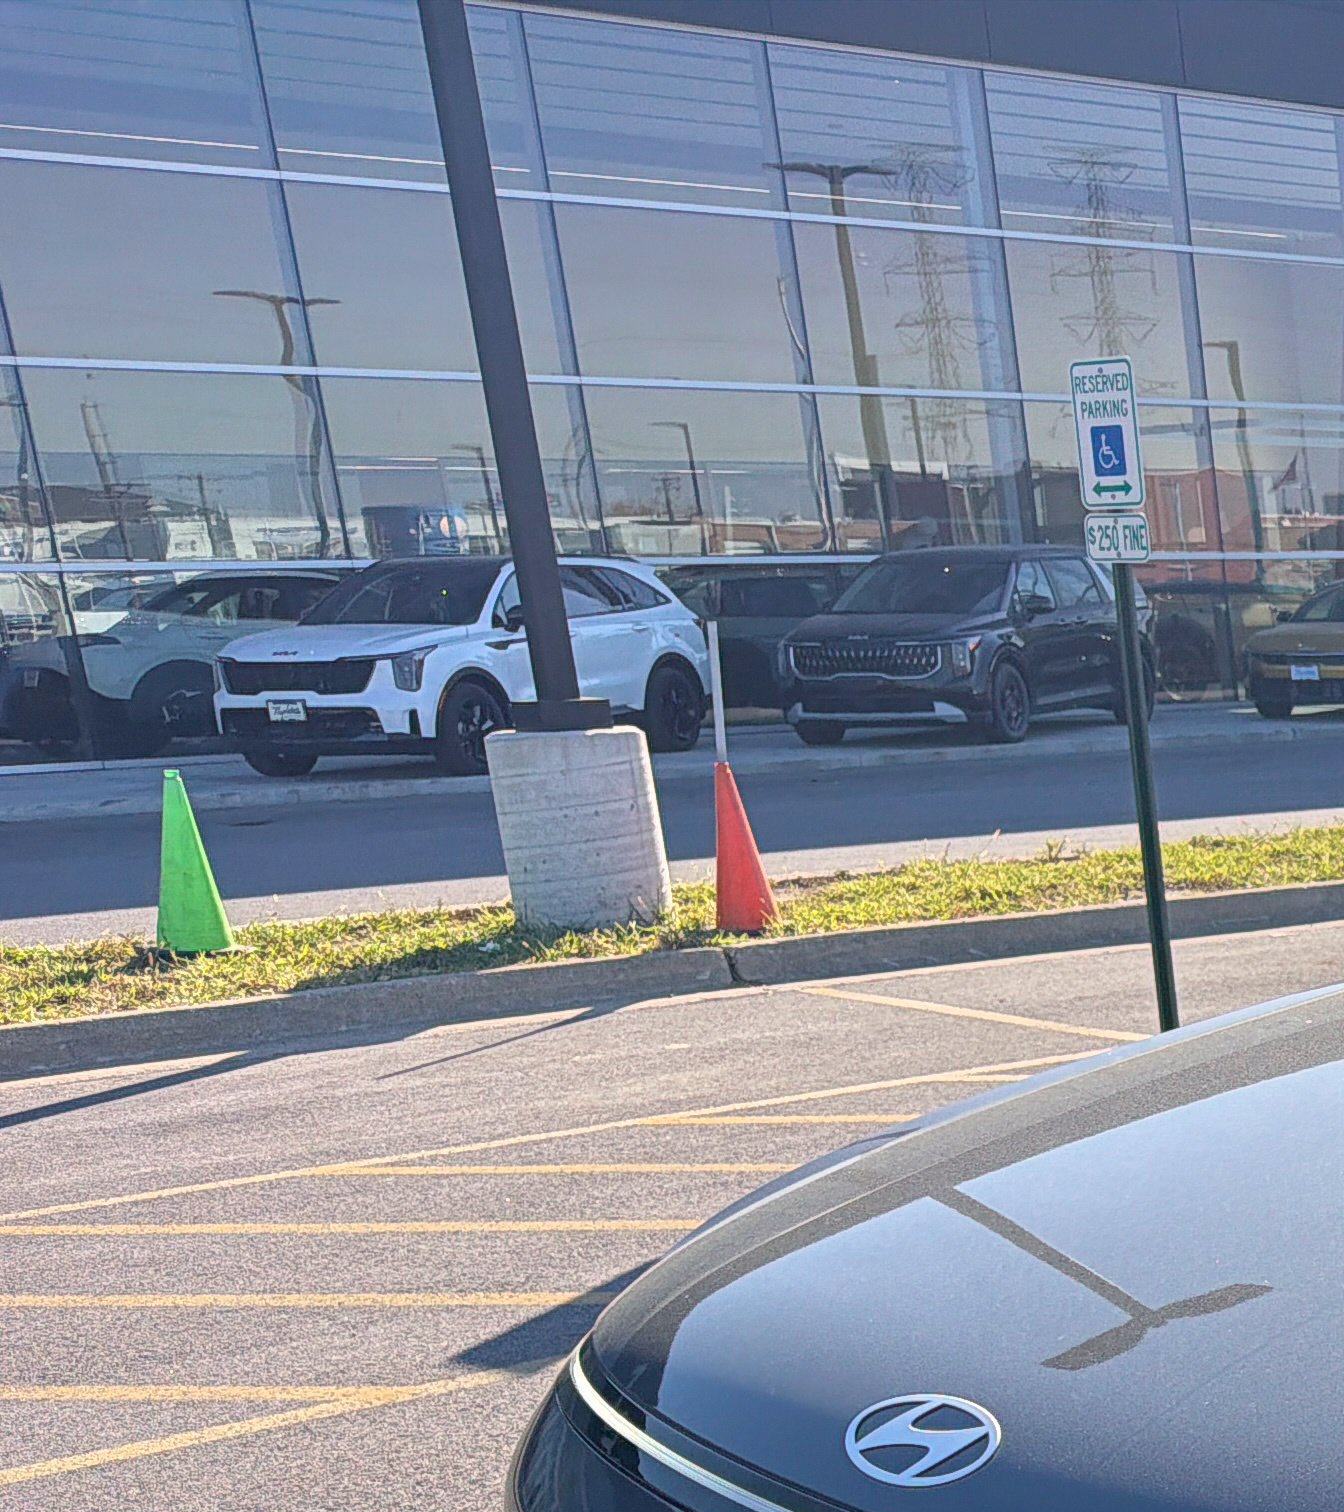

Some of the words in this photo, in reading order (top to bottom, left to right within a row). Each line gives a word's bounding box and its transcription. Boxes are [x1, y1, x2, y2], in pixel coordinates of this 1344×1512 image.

[1074, 372, 1129, 394] RESERVED
[1080, 398, 1128, 420] PARKING
[1088, 525, 1119, 551] $250
[1122, 524, 1147, 550] FINE
